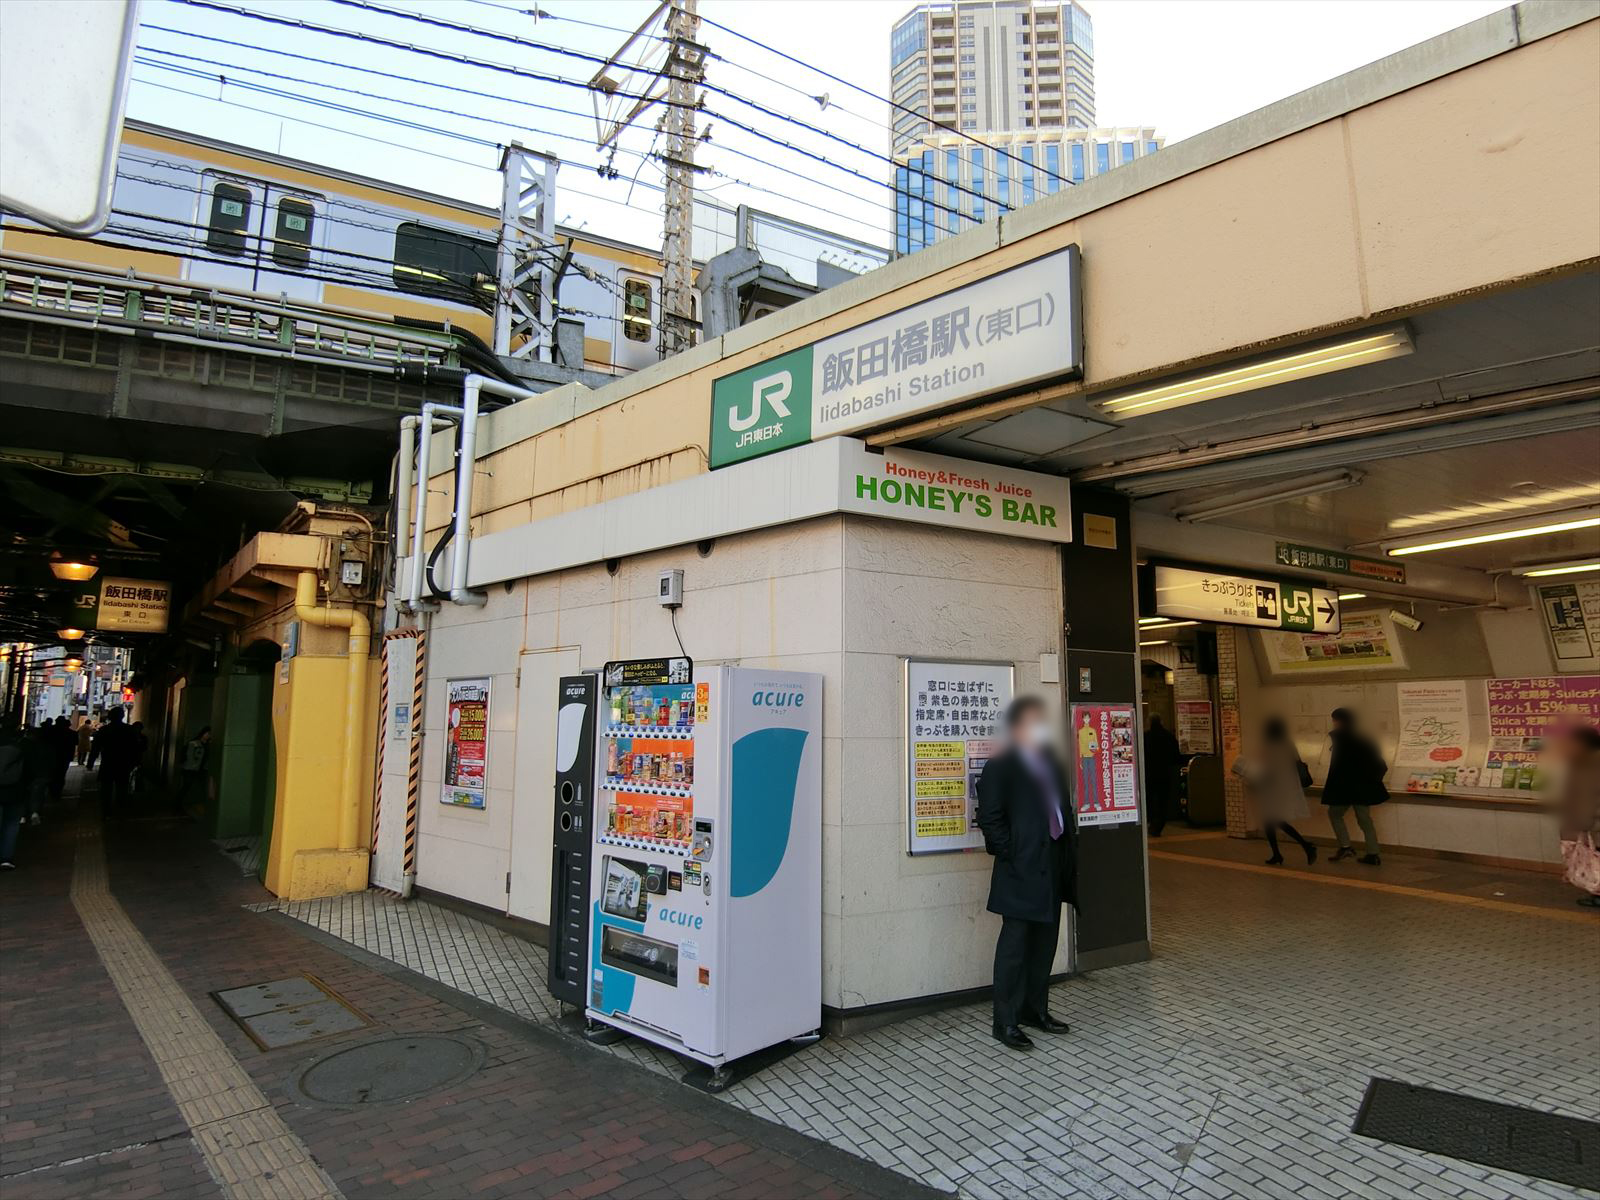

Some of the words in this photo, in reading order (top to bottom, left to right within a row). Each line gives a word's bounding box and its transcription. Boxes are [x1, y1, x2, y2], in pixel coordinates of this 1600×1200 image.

[728, 369, 793, 432] JR
[819, 382, 903, 424] Iidabashi
[909, 360, 986, 399] Station
[735, 422, 784, 449] JR東日本
[885, 462, 990, 492] Honey&Fresh
[994, 480, 1033, 498] Juice
[856, 475, 992, 518] HONEY'S
[1001, 499, 1057, 528] BAR
[105, 584, 168, 602] 飯田橋駅
[1202, 579, 1254, 598] きっぷうりば
[75, 594, 97, 605] JR
[103, 599, 139, 609] Iidabashi
[140, 602, 168, 611] Station
[1235, 599, 1254, 608] Tickets
[1283, 590, 1311, 616] JR
[566, 687, 586, 696] acure
[927, 680, 994, 693] 窓口に並ばずに
[752, 691, 805, 707] acure
[931, 695, 999, 707] 紫色の券売機で
[915, 724, 998, 736] きっぷを購入できま
[659, 907, 704, 930] acure
